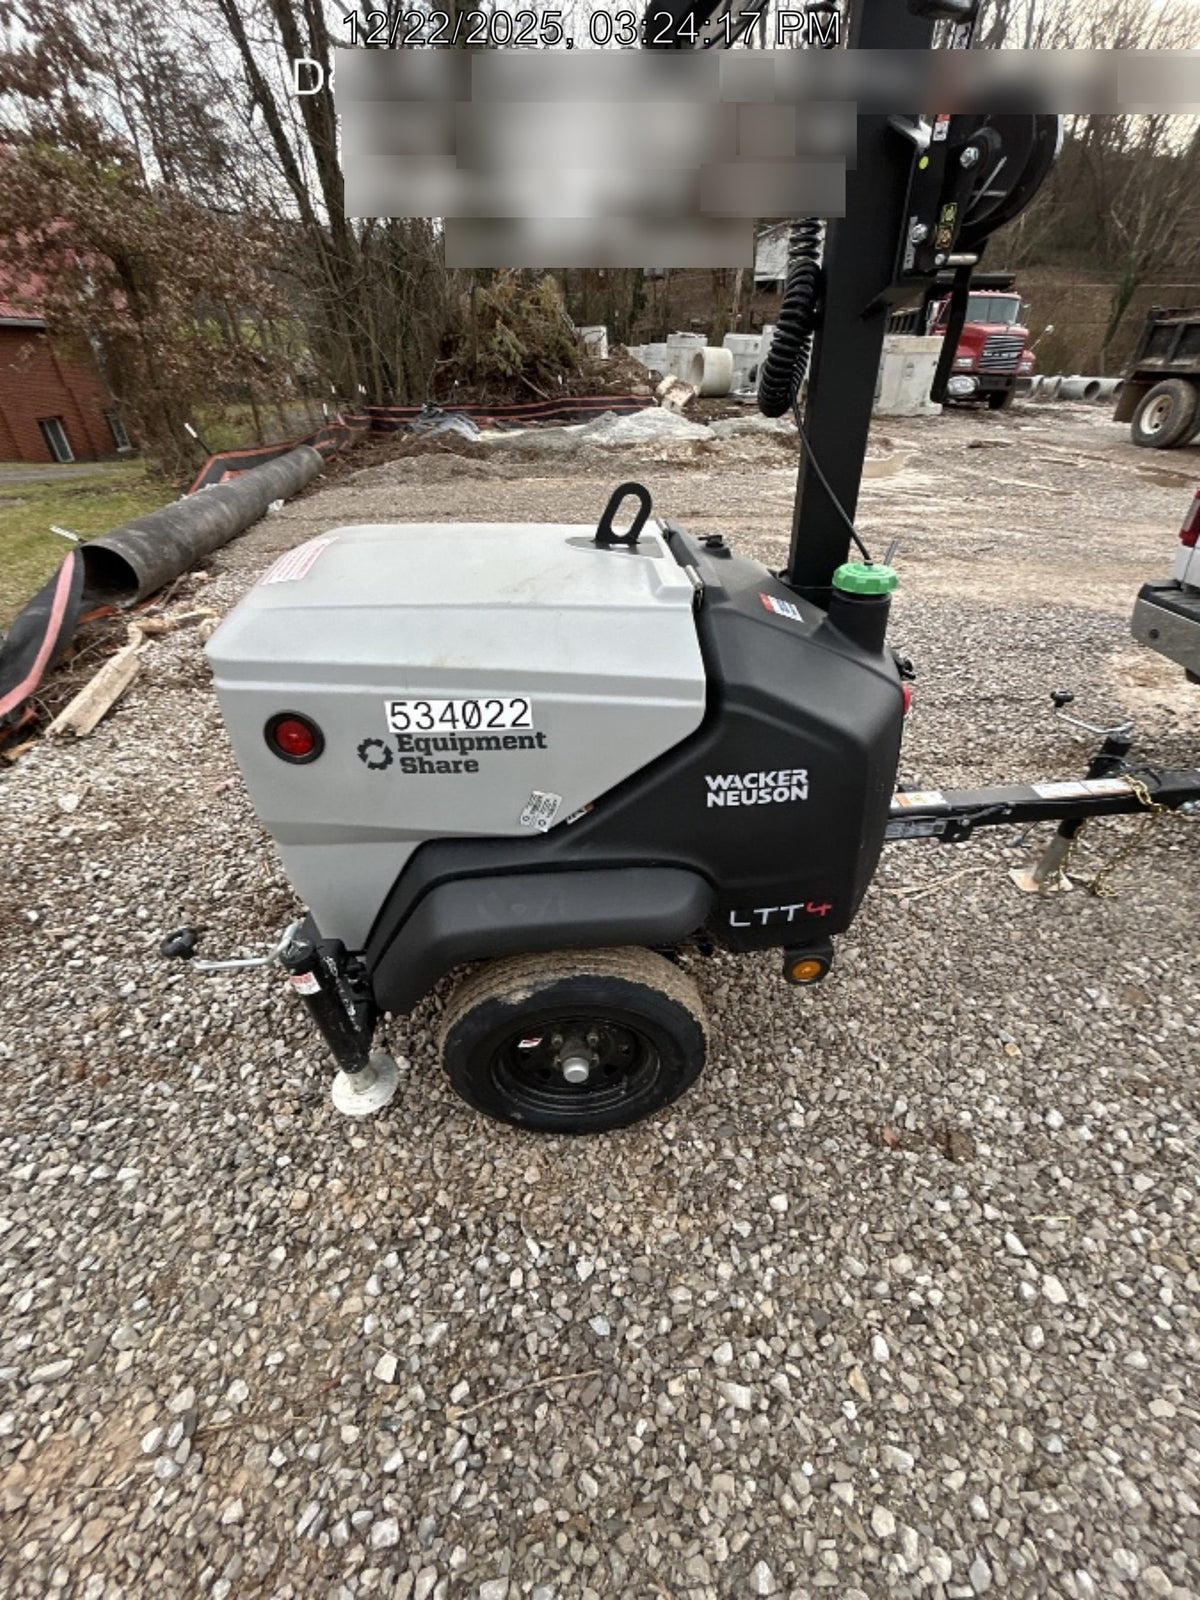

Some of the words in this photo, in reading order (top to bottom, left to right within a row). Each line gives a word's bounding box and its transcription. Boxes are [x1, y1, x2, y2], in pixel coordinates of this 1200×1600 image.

[391, 699, 530, 730] 534022
[396, 733, 547, 754] Equipment
[401, 758, 479, 773] Share
[705, 770, 808, 791] WACKER
[707, 786, 808, 807] NEUSON
